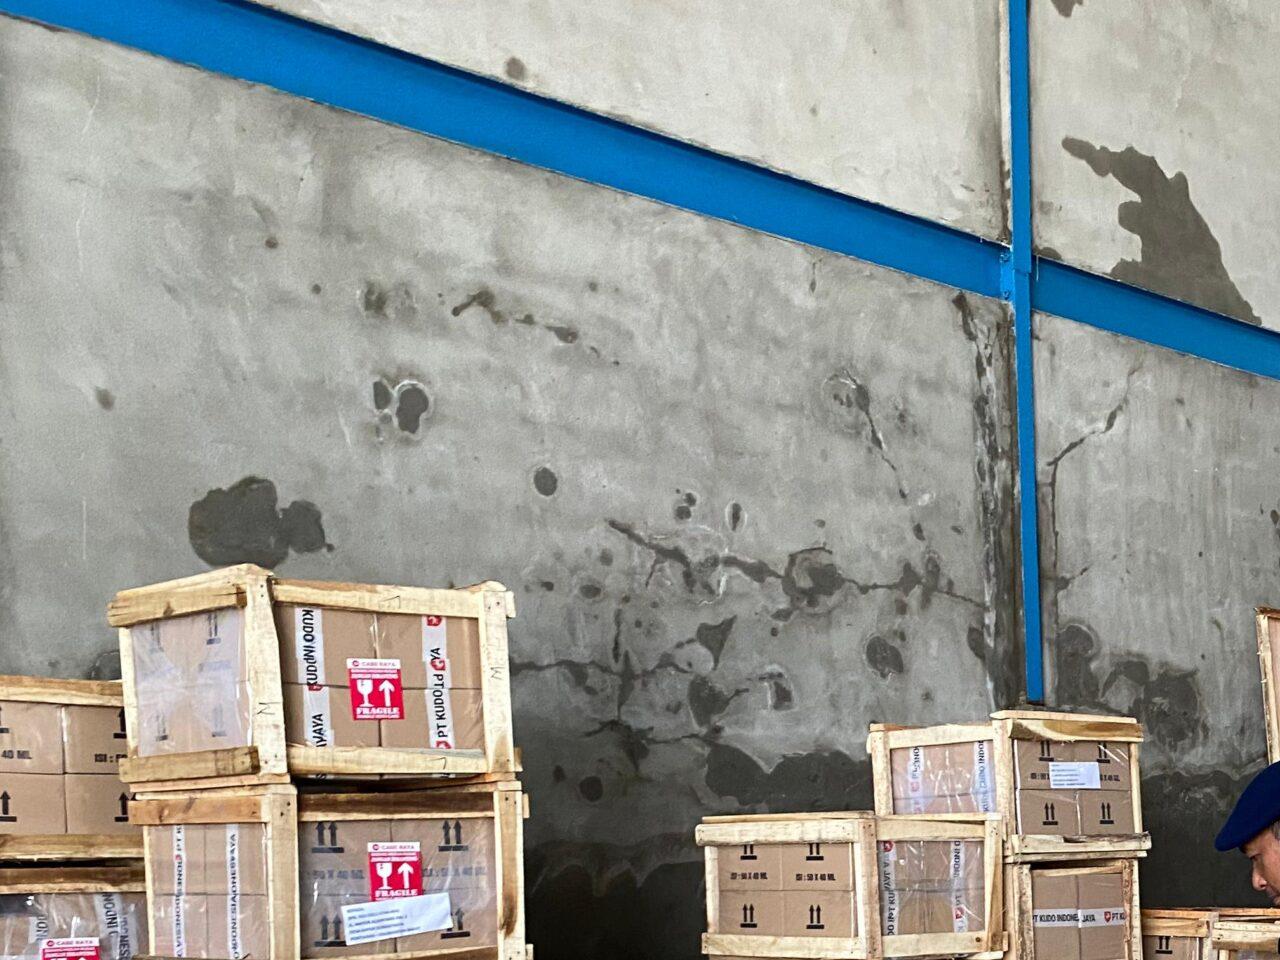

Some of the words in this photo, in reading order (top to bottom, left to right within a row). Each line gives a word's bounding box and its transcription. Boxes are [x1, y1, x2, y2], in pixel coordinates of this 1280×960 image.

[301, 609, 315, 643] KUDO
[356, 706, 399, 715] FRAGILE
[436, 723, 447, 738] PT
[374, 888, 418, 898] FRAGILE
